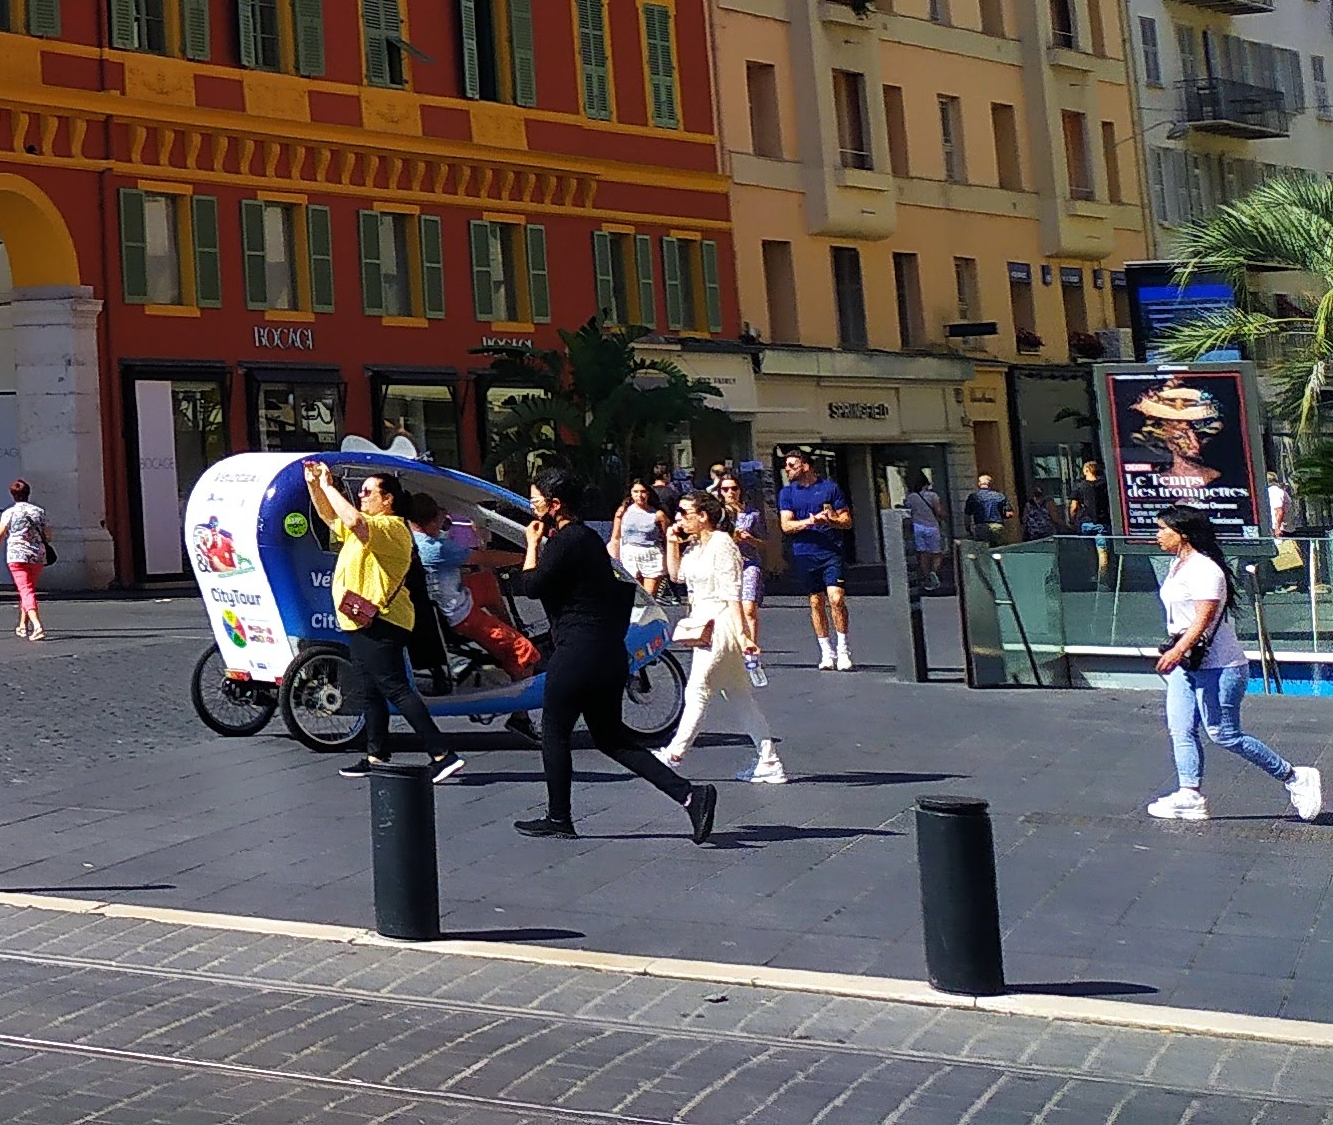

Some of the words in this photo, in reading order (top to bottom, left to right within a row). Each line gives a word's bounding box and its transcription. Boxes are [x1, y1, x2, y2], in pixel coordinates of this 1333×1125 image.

[828, 402, 889, 420] SPRINGFIELD
[1125, 473, 1147, 486] Le
[1149, 473, 1205, 488] Temps
[1127, 483, 1157, 498] des
[1158, 486, 1250, 500] trompettes
[210, 587, 262, 607] CityTour
